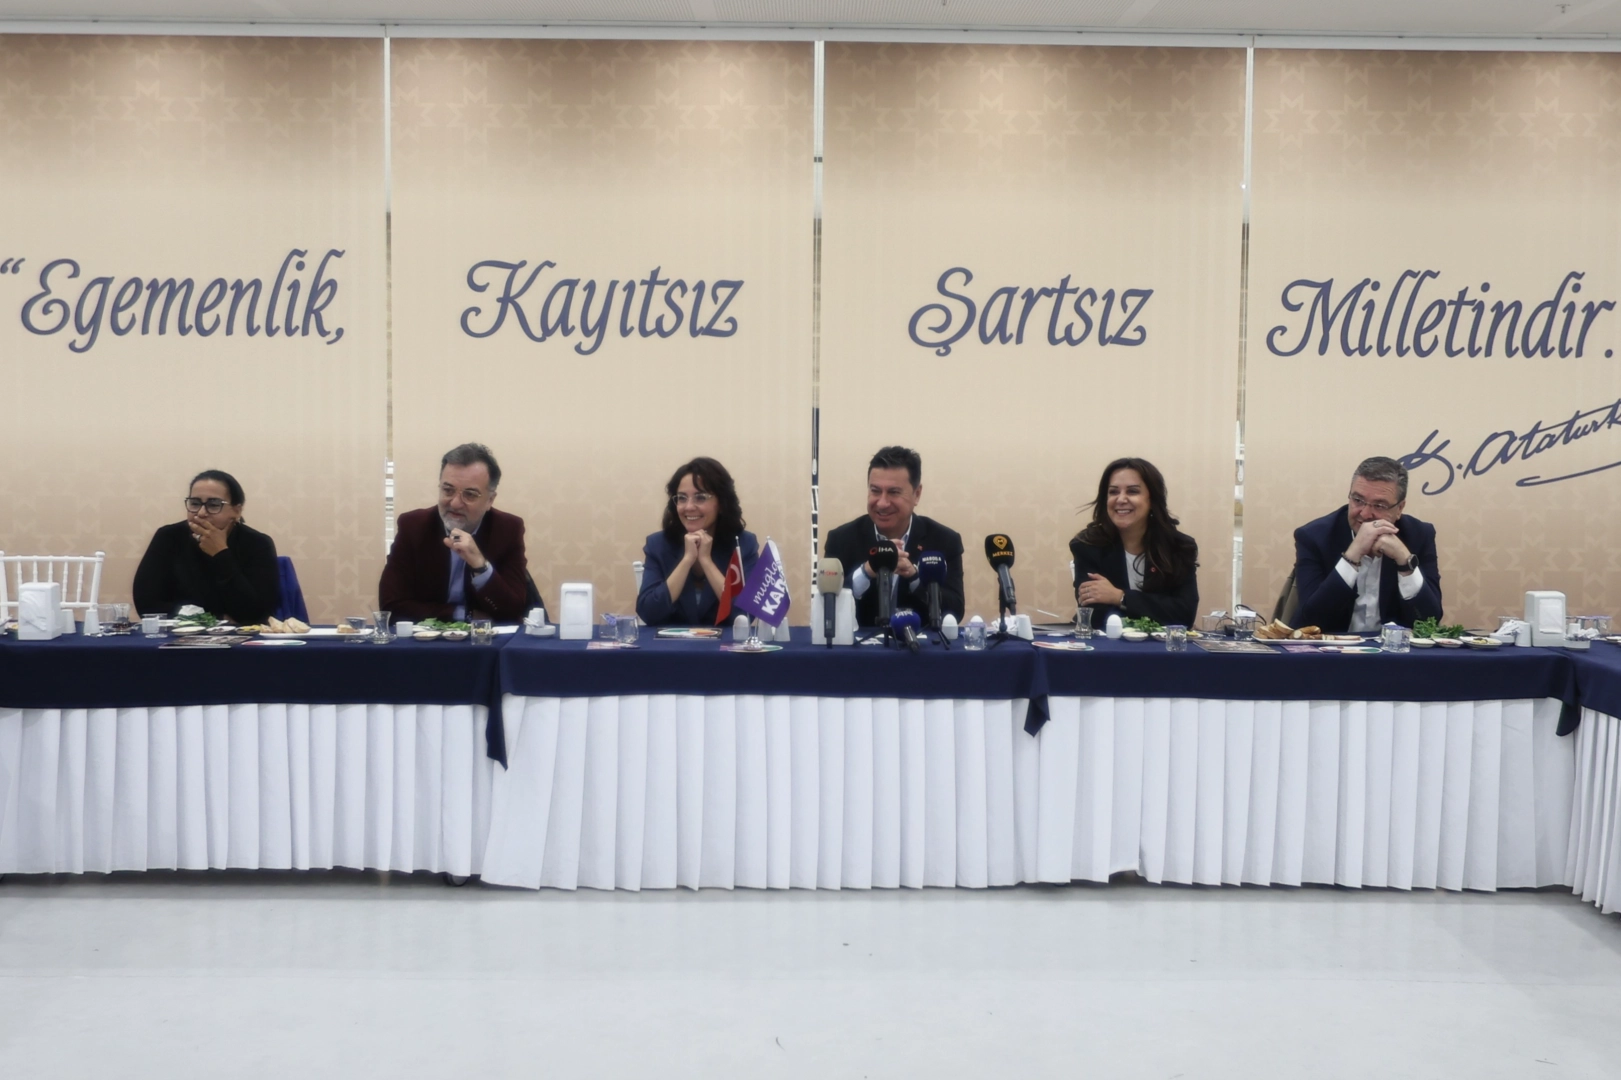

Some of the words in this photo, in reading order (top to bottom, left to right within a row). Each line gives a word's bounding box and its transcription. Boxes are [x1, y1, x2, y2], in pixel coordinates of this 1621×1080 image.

[460, 259, 745, 356] Kayıtsız
[908, 266, 1154, 357] Şartsız
[1265, 269, 1617, 359] Milletindir.
